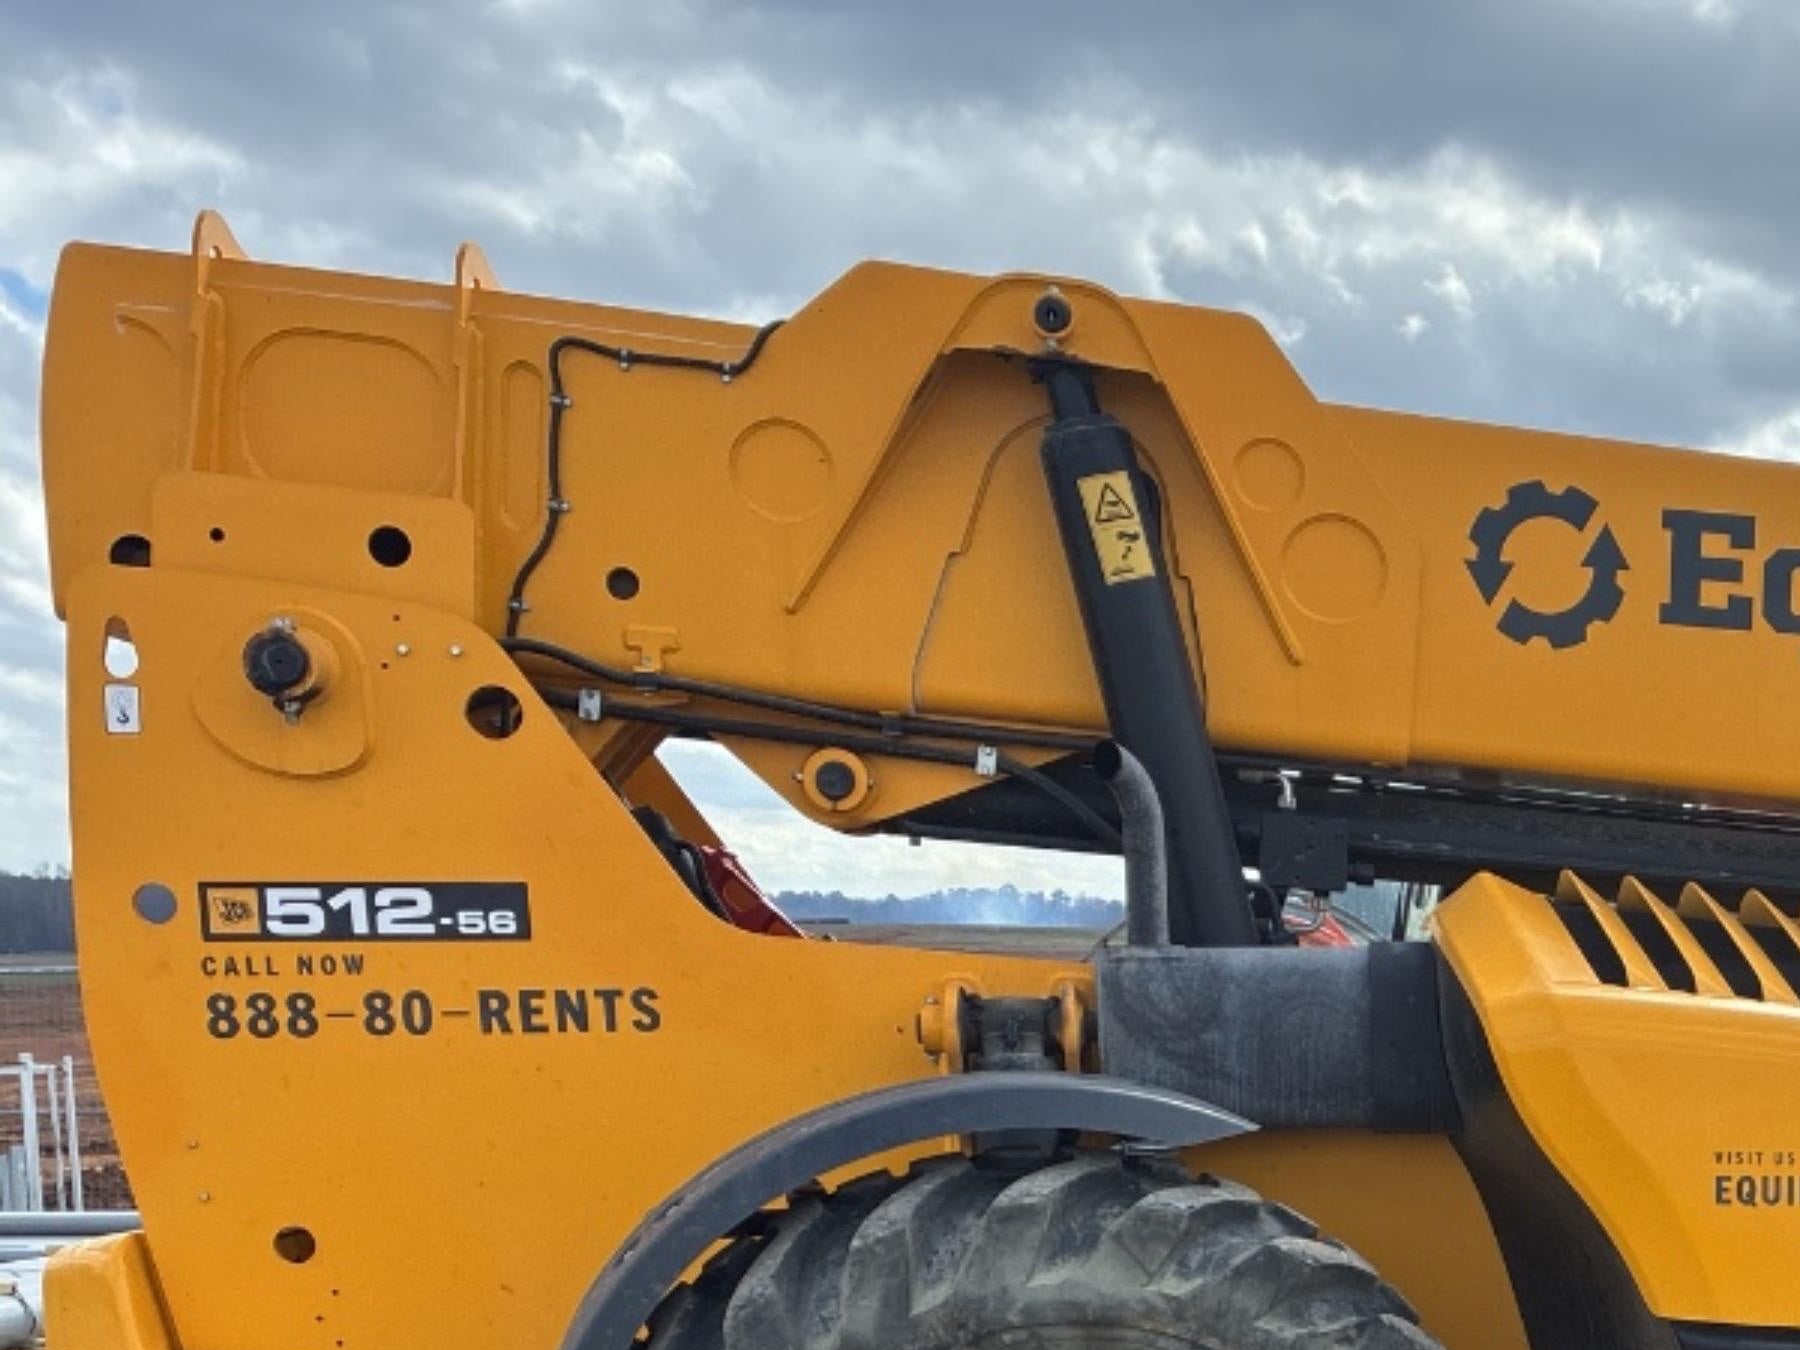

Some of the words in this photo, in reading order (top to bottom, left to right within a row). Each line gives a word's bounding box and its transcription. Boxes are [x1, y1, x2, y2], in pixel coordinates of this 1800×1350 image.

[264, 887, 517, 936] 512-56
[201, 955, 281, 978] CALL
[296, 953, 365, 977] NOW
[206, 986, 662, 1039] 888-80-RENTS
[1713, 1151, 1764, 1166] VISIT
[1773, 1151, 1796, 1166] US
